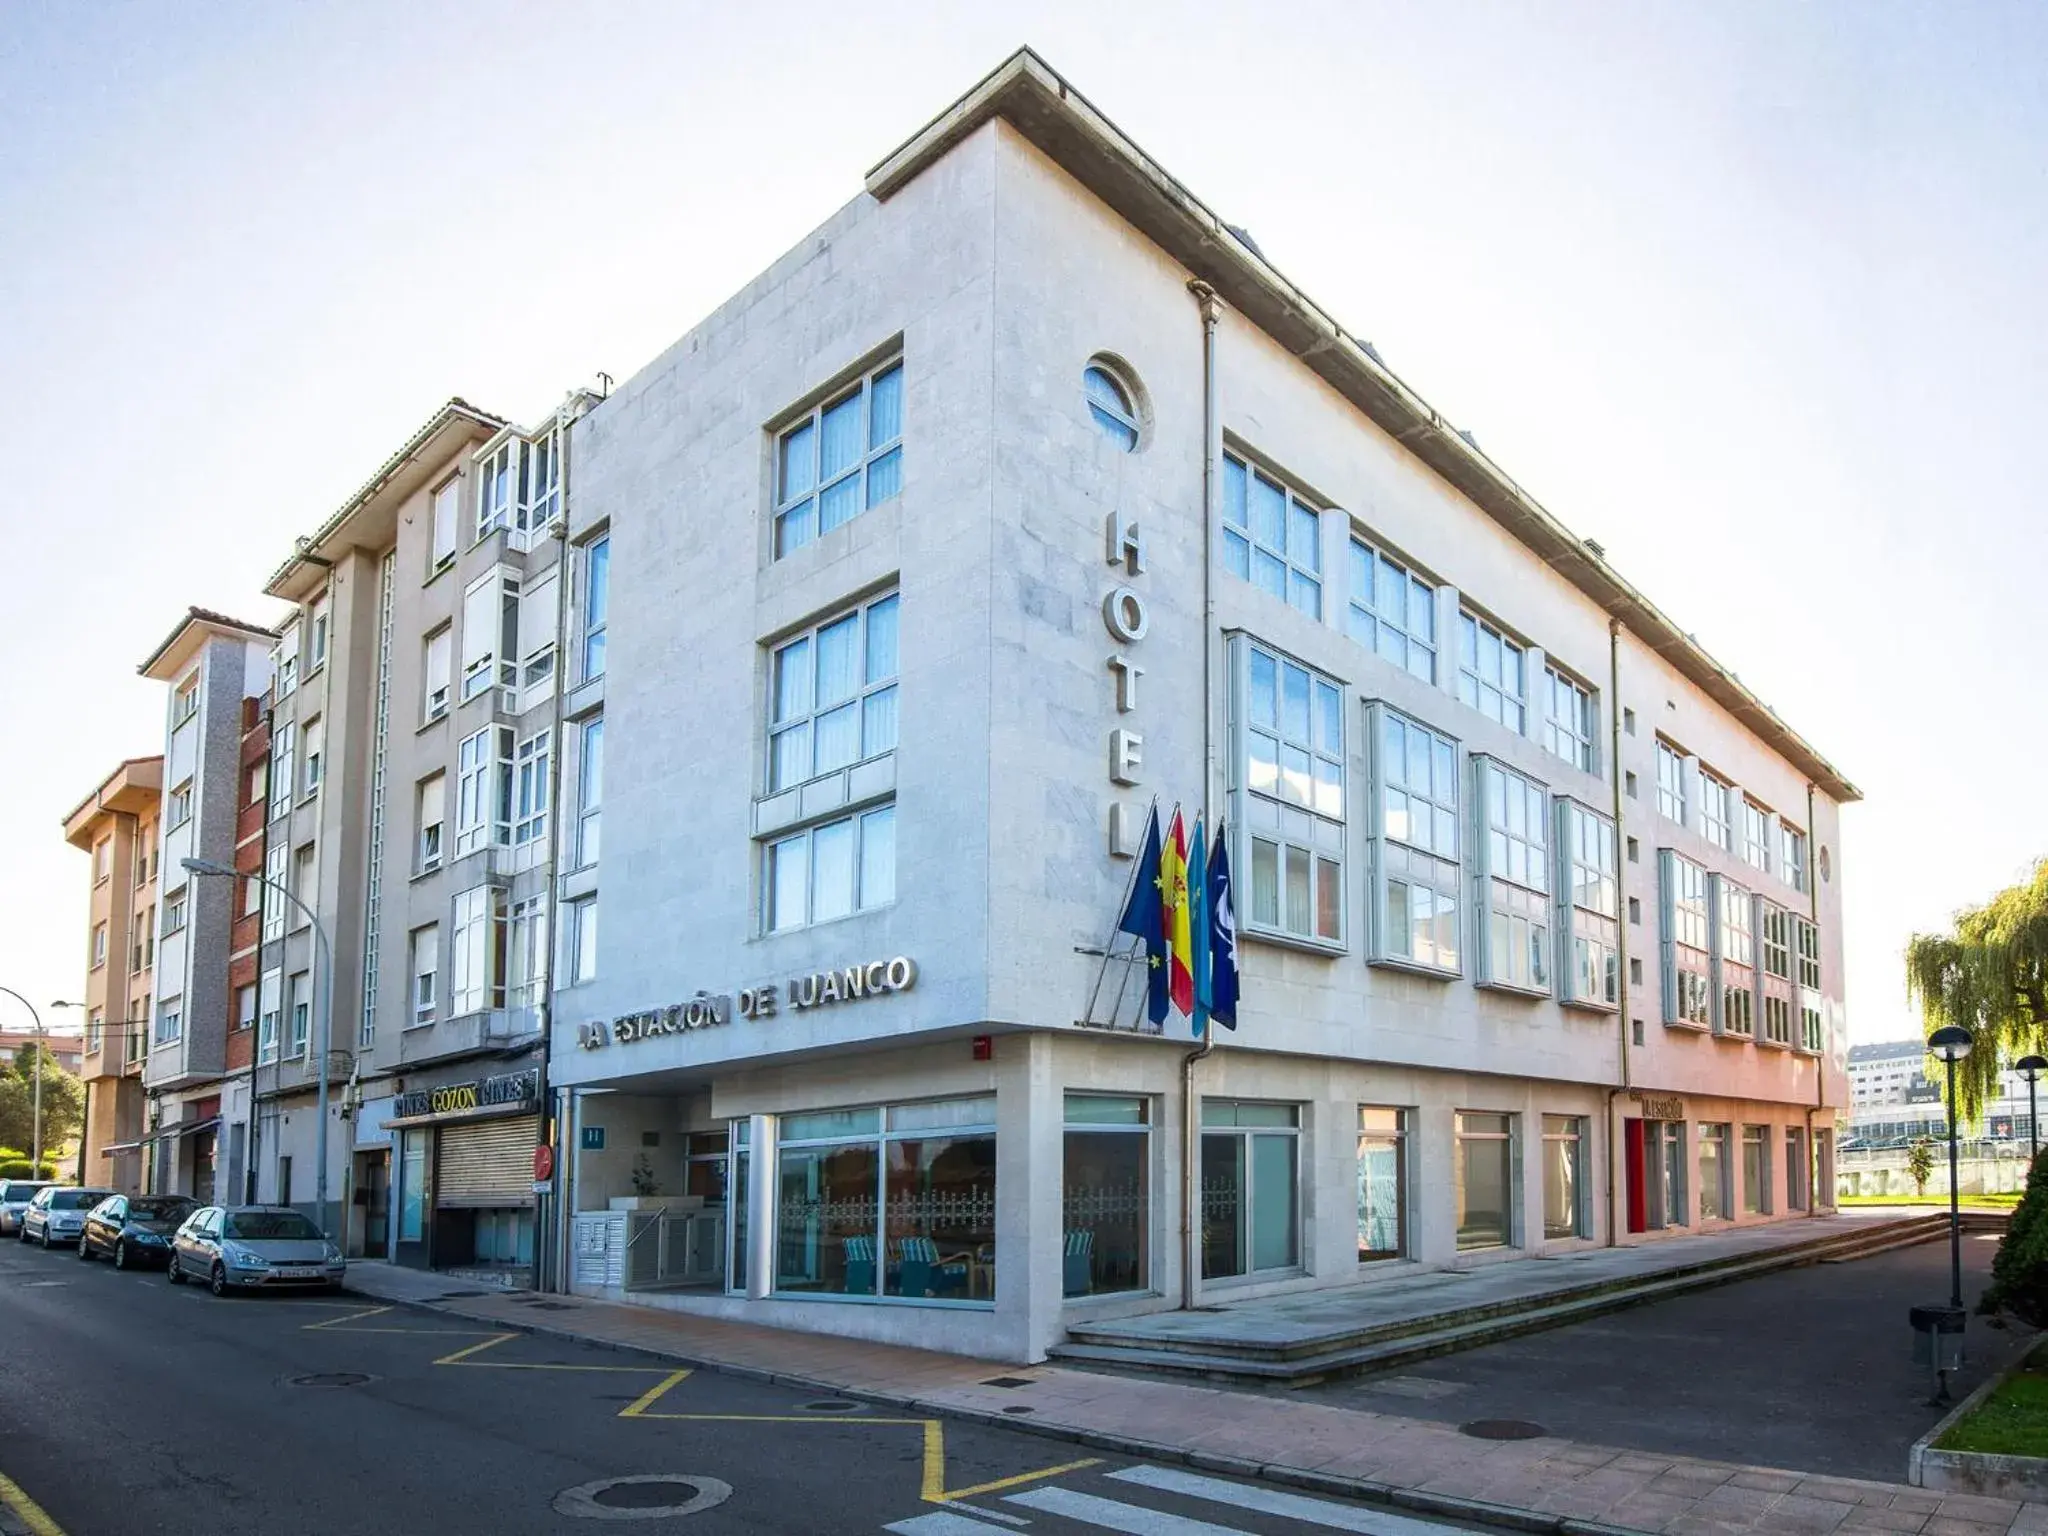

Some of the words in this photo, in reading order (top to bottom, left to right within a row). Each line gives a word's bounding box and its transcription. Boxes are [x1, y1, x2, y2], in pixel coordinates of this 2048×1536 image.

[1103, 508, 1148, 860] HOTEL
[577, 1021, 608, 1049] LA
[612, 990, 731, 1044] ESTACIÓN
[736, 984, 777, 1019] DE
[786, 955, 918, 1011] LUANCO
